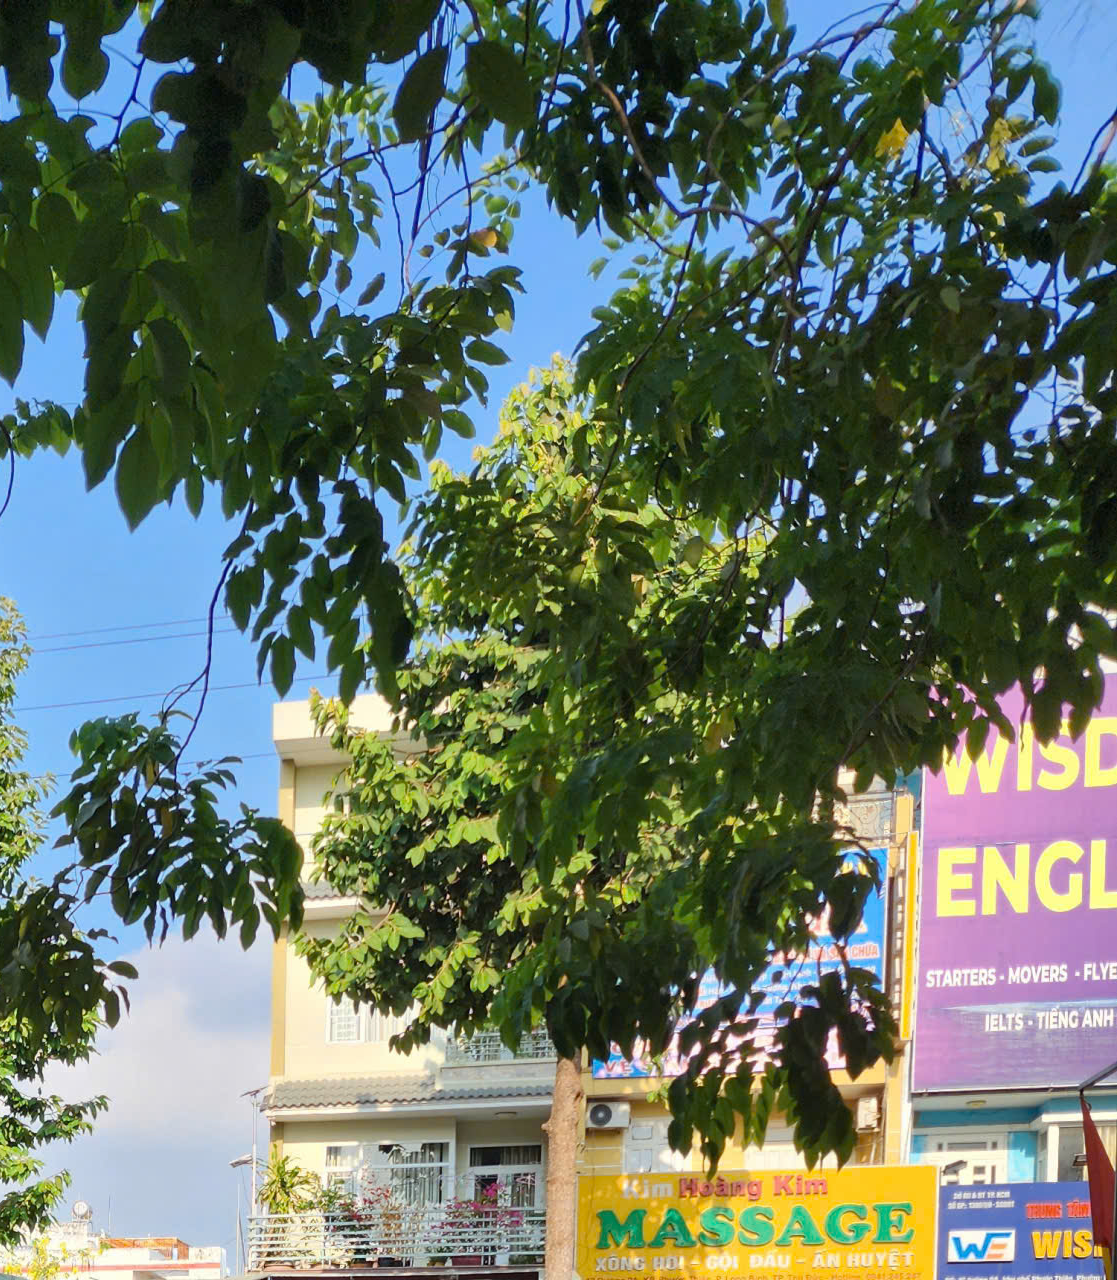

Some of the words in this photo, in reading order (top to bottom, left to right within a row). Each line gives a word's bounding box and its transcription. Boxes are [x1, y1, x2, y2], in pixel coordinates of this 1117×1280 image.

[936, 839, 1117, 917] ENGL
[925, 967, 996, 988] STARTERS
[1008, 963, 1068, 984] MOVERS
[985, 1010, 1024, 1032] IELTS
[1036, 1005, 1079, 1030] TIẾNG
[1082, 1009, 1114, 1029] ANH
[679, 1175, 763, 1200] Hoàng
[773, 1175, 828, 1197] Kim
[596, 1201, 915, 1249] MASSAGE
[595, 1252, 645, 1272] XÔNG
[749, 1249, 791, 1270] ĐẦU
[846, 1250, 914, 1273] HUYỆT
